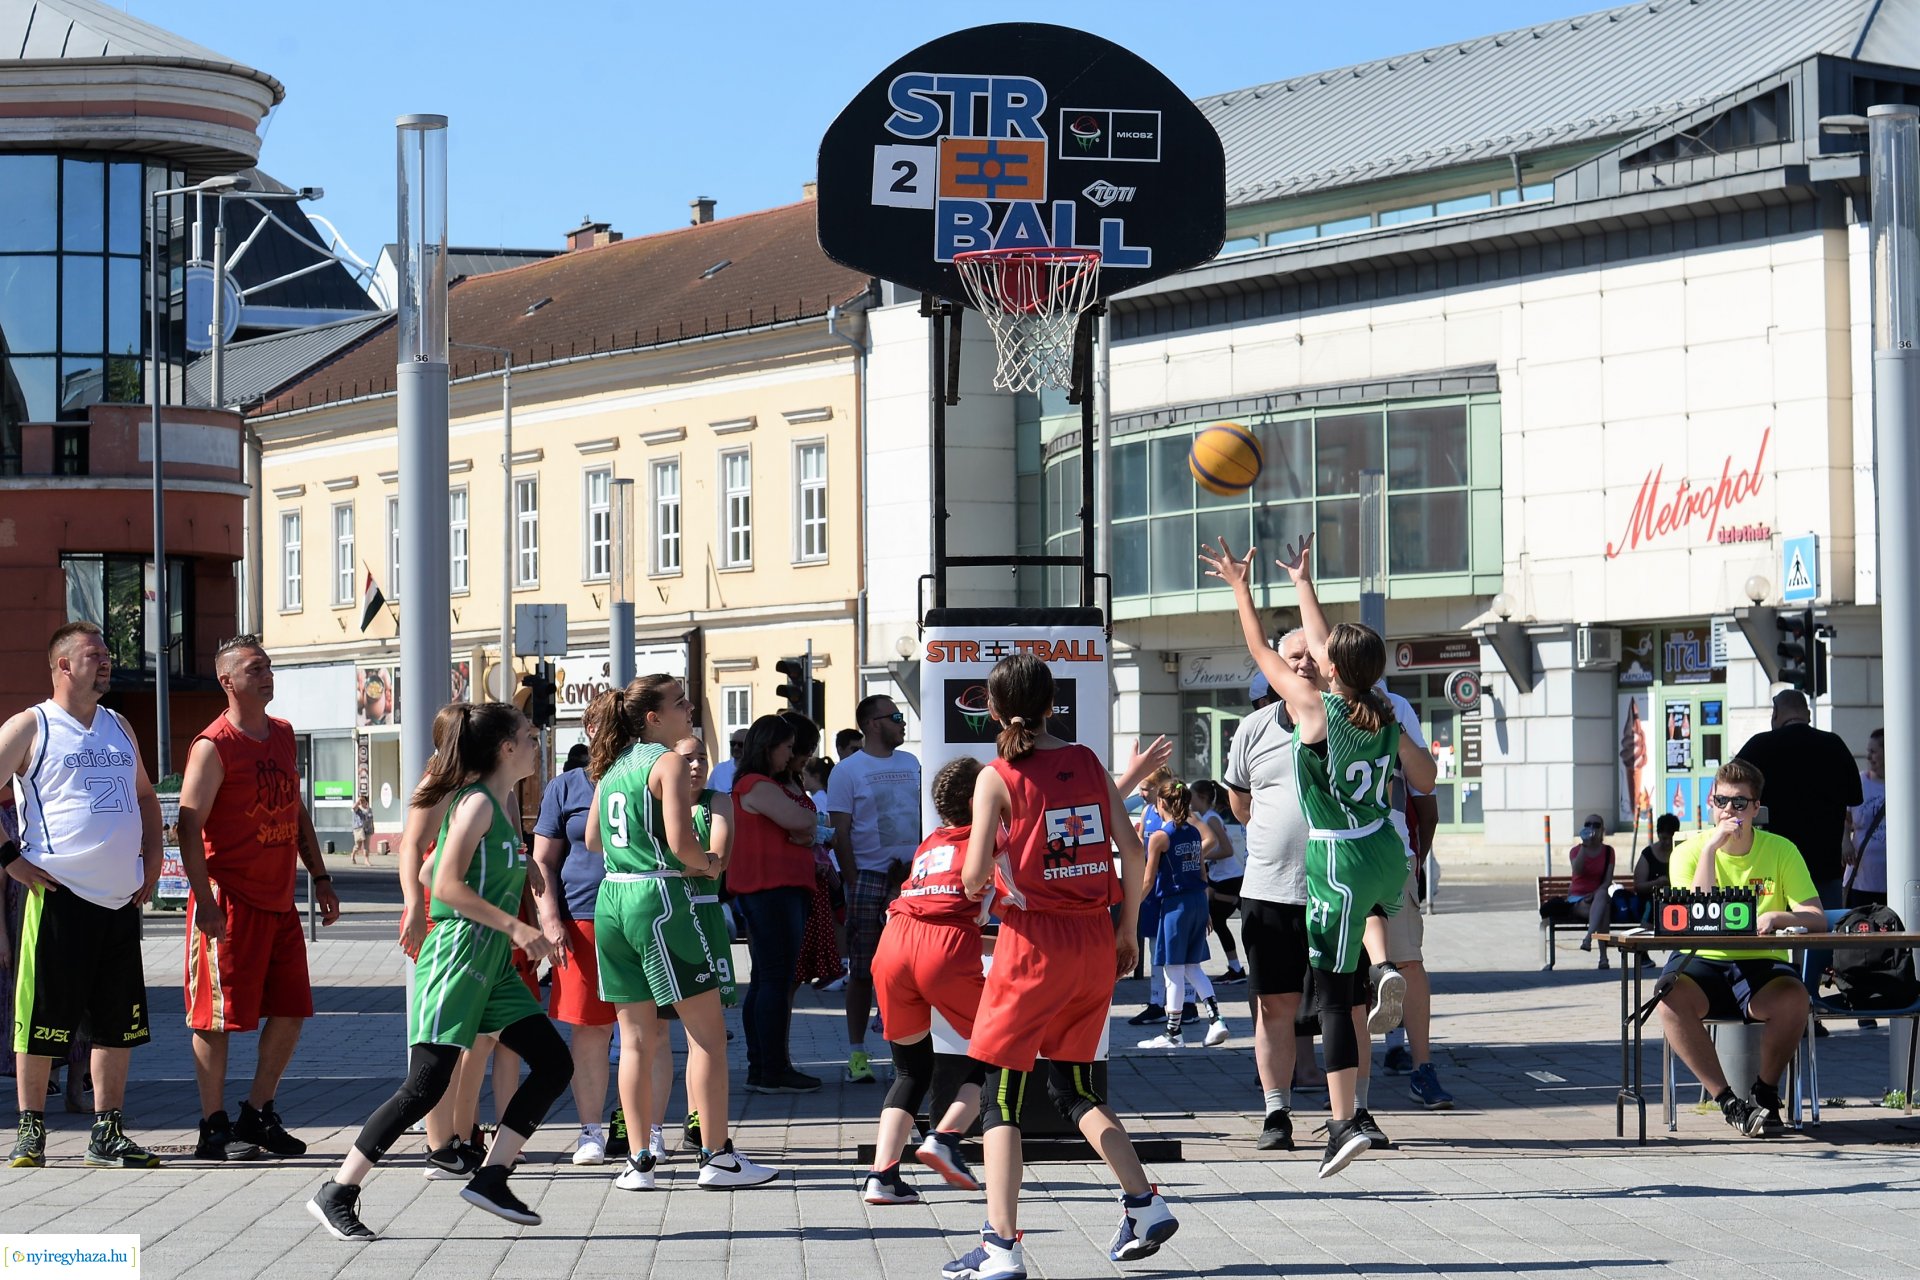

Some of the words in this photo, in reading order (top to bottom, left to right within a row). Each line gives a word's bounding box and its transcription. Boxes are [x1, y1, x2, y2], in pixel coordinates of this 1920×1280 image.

[1116, 131, 1153, 139] MKOSZ
[889, 160, 918, 194] 2
[934, 200, 1152, 268] BALL
[1606, 426, 1770, 558] Metropol
[1185, 656, 1236, 685] Firenze
[64, 748, 133, 768] adidas
[85, 777, 133, 814] 21
[1345, 754, 1391, 808] 21
[607, 791, 630, 848] 9
[1310, 896, 1330, 928] 21
[1663, 904, 1689, 932] 0
[1724, 902, 1749, 930] 9
[1694, 924, 1718, 932] molten
[716, 958, 731, 983] 9
